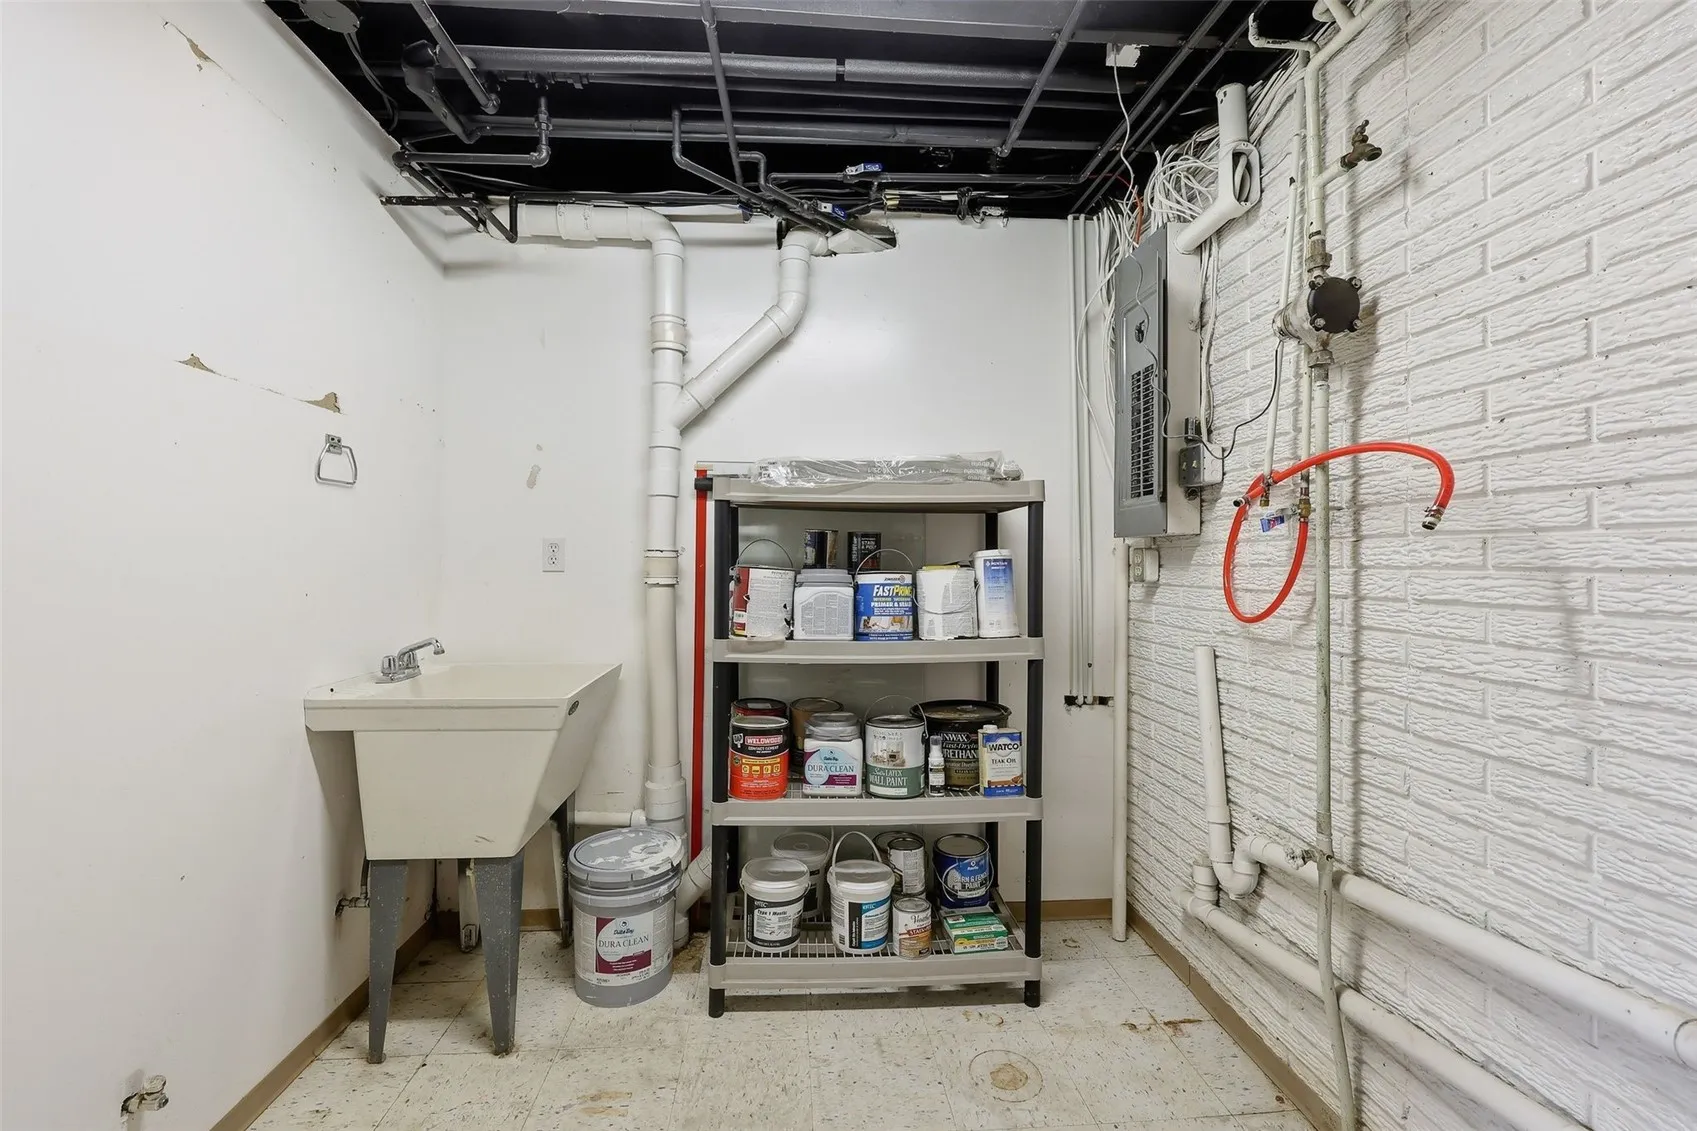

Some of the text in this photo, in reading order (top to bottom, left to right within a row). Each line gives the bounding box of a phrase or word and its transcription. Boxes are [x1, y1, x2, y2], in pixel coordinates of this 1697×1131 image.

[988, 743, 1019, 751] WATCO
[808, 765, 855, 773] DURA CLEAN
[886, 777, 908, 787] PAINT
[598, 935, 650, 949] DURA CLEAN
